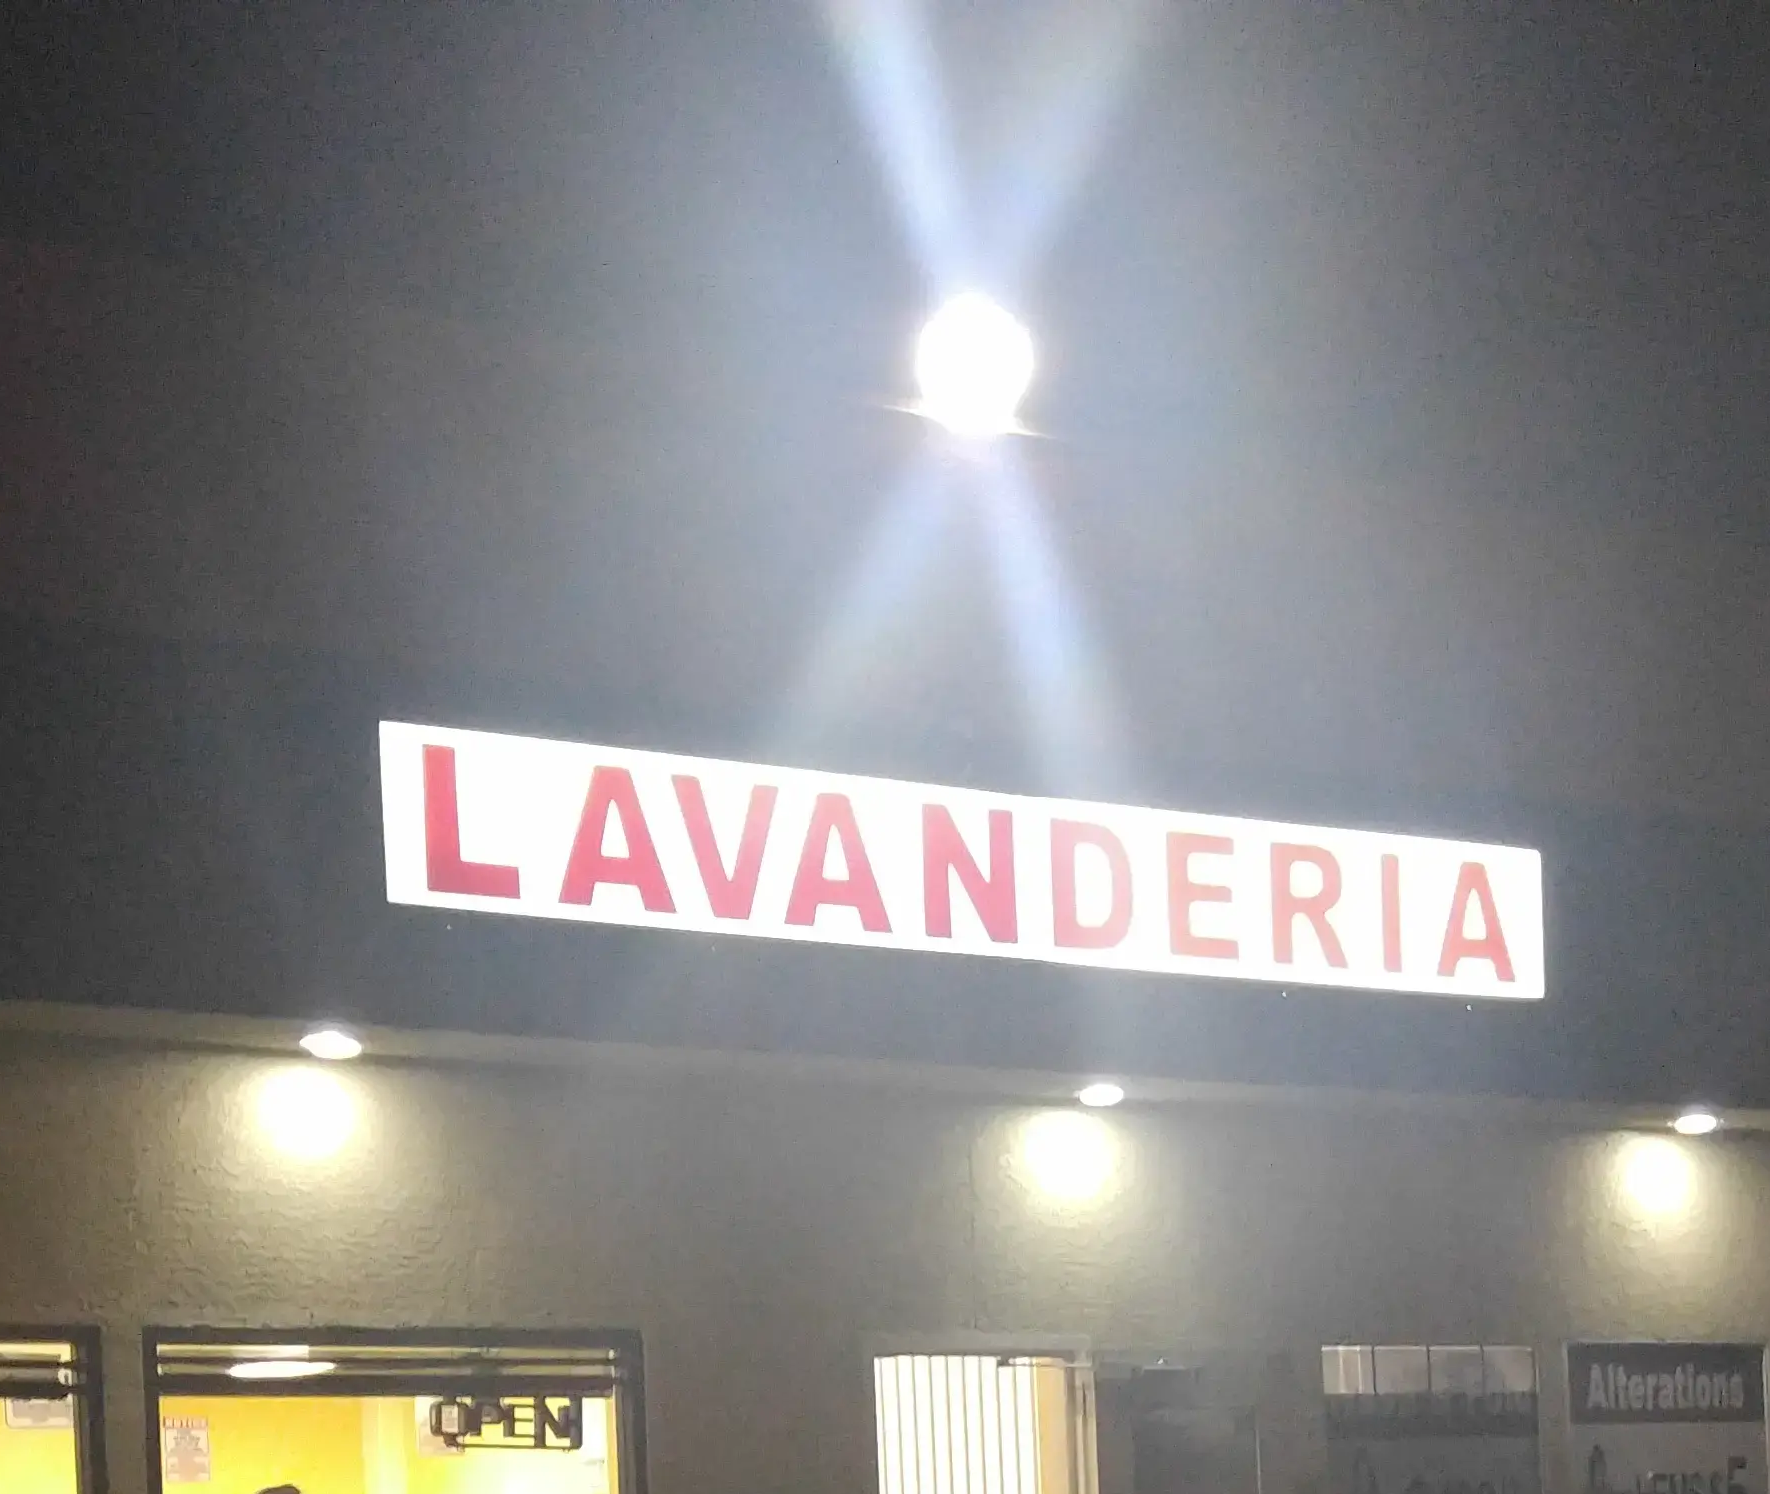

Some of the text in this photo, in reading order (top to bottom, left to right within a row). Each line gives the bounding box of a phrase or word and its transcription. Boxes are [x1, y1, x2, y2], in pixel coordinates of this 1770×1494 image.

[422, 744, 1516, 983] LAVANDERIA
[1586, 1361, 1746, 1412] Alterations
[430, 1396, 582, 1448] OPEN
